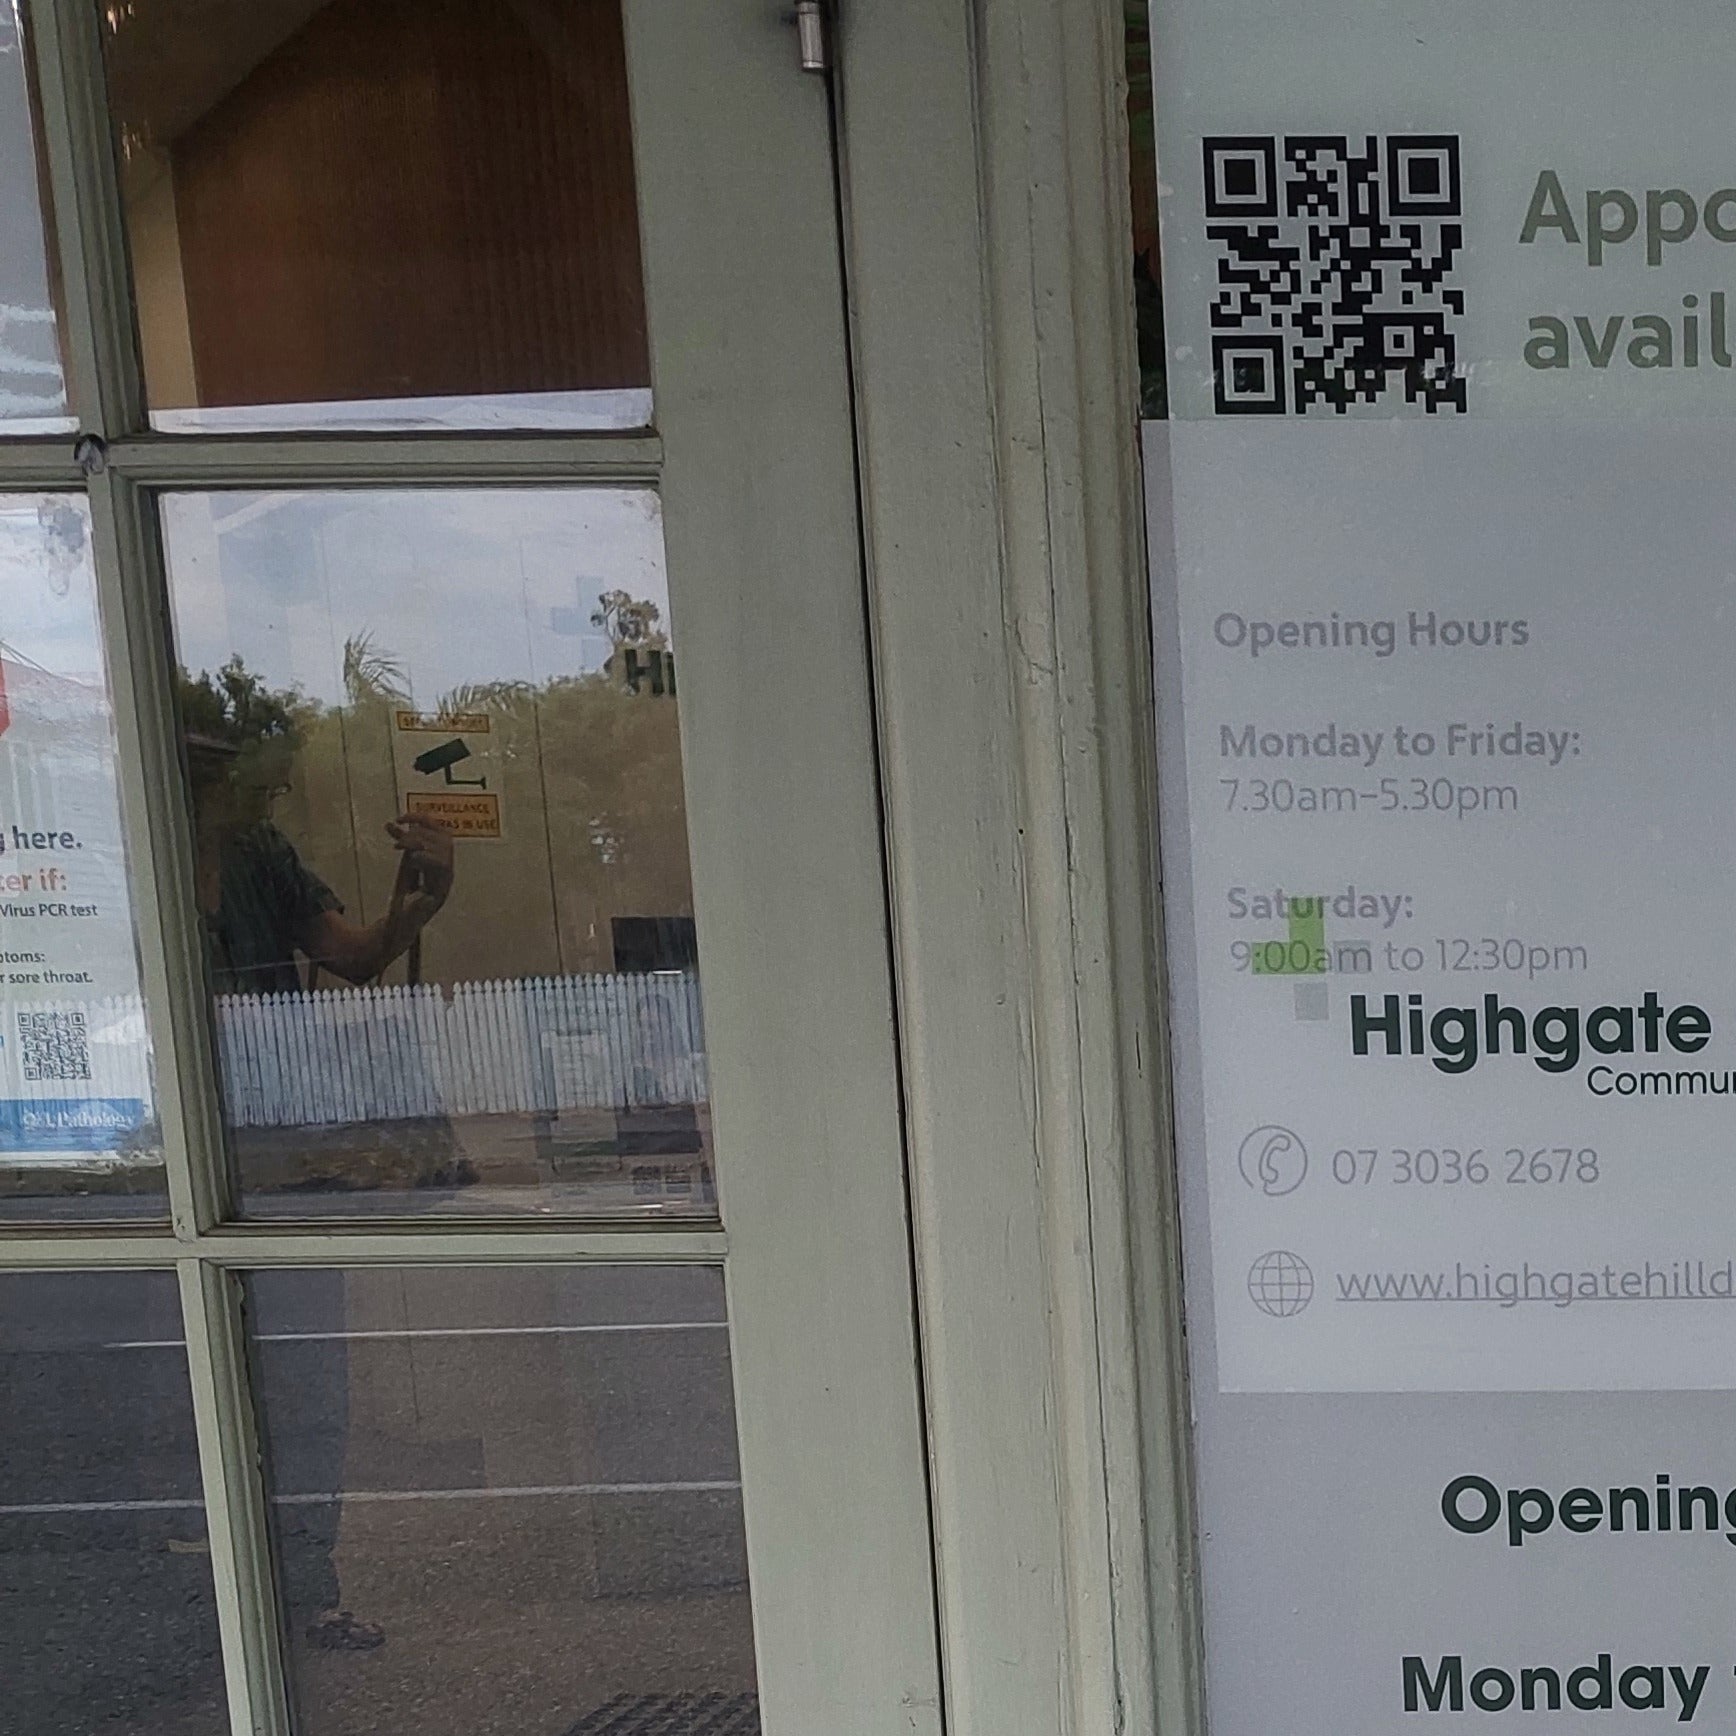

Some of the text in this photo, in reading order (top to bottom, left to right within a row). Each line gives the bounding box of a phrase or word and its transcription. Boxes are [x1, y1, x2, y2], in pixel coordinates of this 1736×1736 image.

[1214, 611, 1529, 657] Opening Hours
[1220, 721, 1580, 764] Monday to Friday:
[12, 825, 83, 849] here.
[40, 867, 67, 891] if:
[39, 903, 69, 917] PCR
[71, 904, 98, 917] test
[1227, 885, 1413, 928] Saturday:
[9, 972, 40, 983] sore
[1231, 935, 1588, 978] 9:00am to 12:30pm
[1351, 992, 1711, 1075] Highgate
[1332, 1148, 1600, 1185] 07 3036 2678
[1402, 1654, 1710, 1722] Monday
